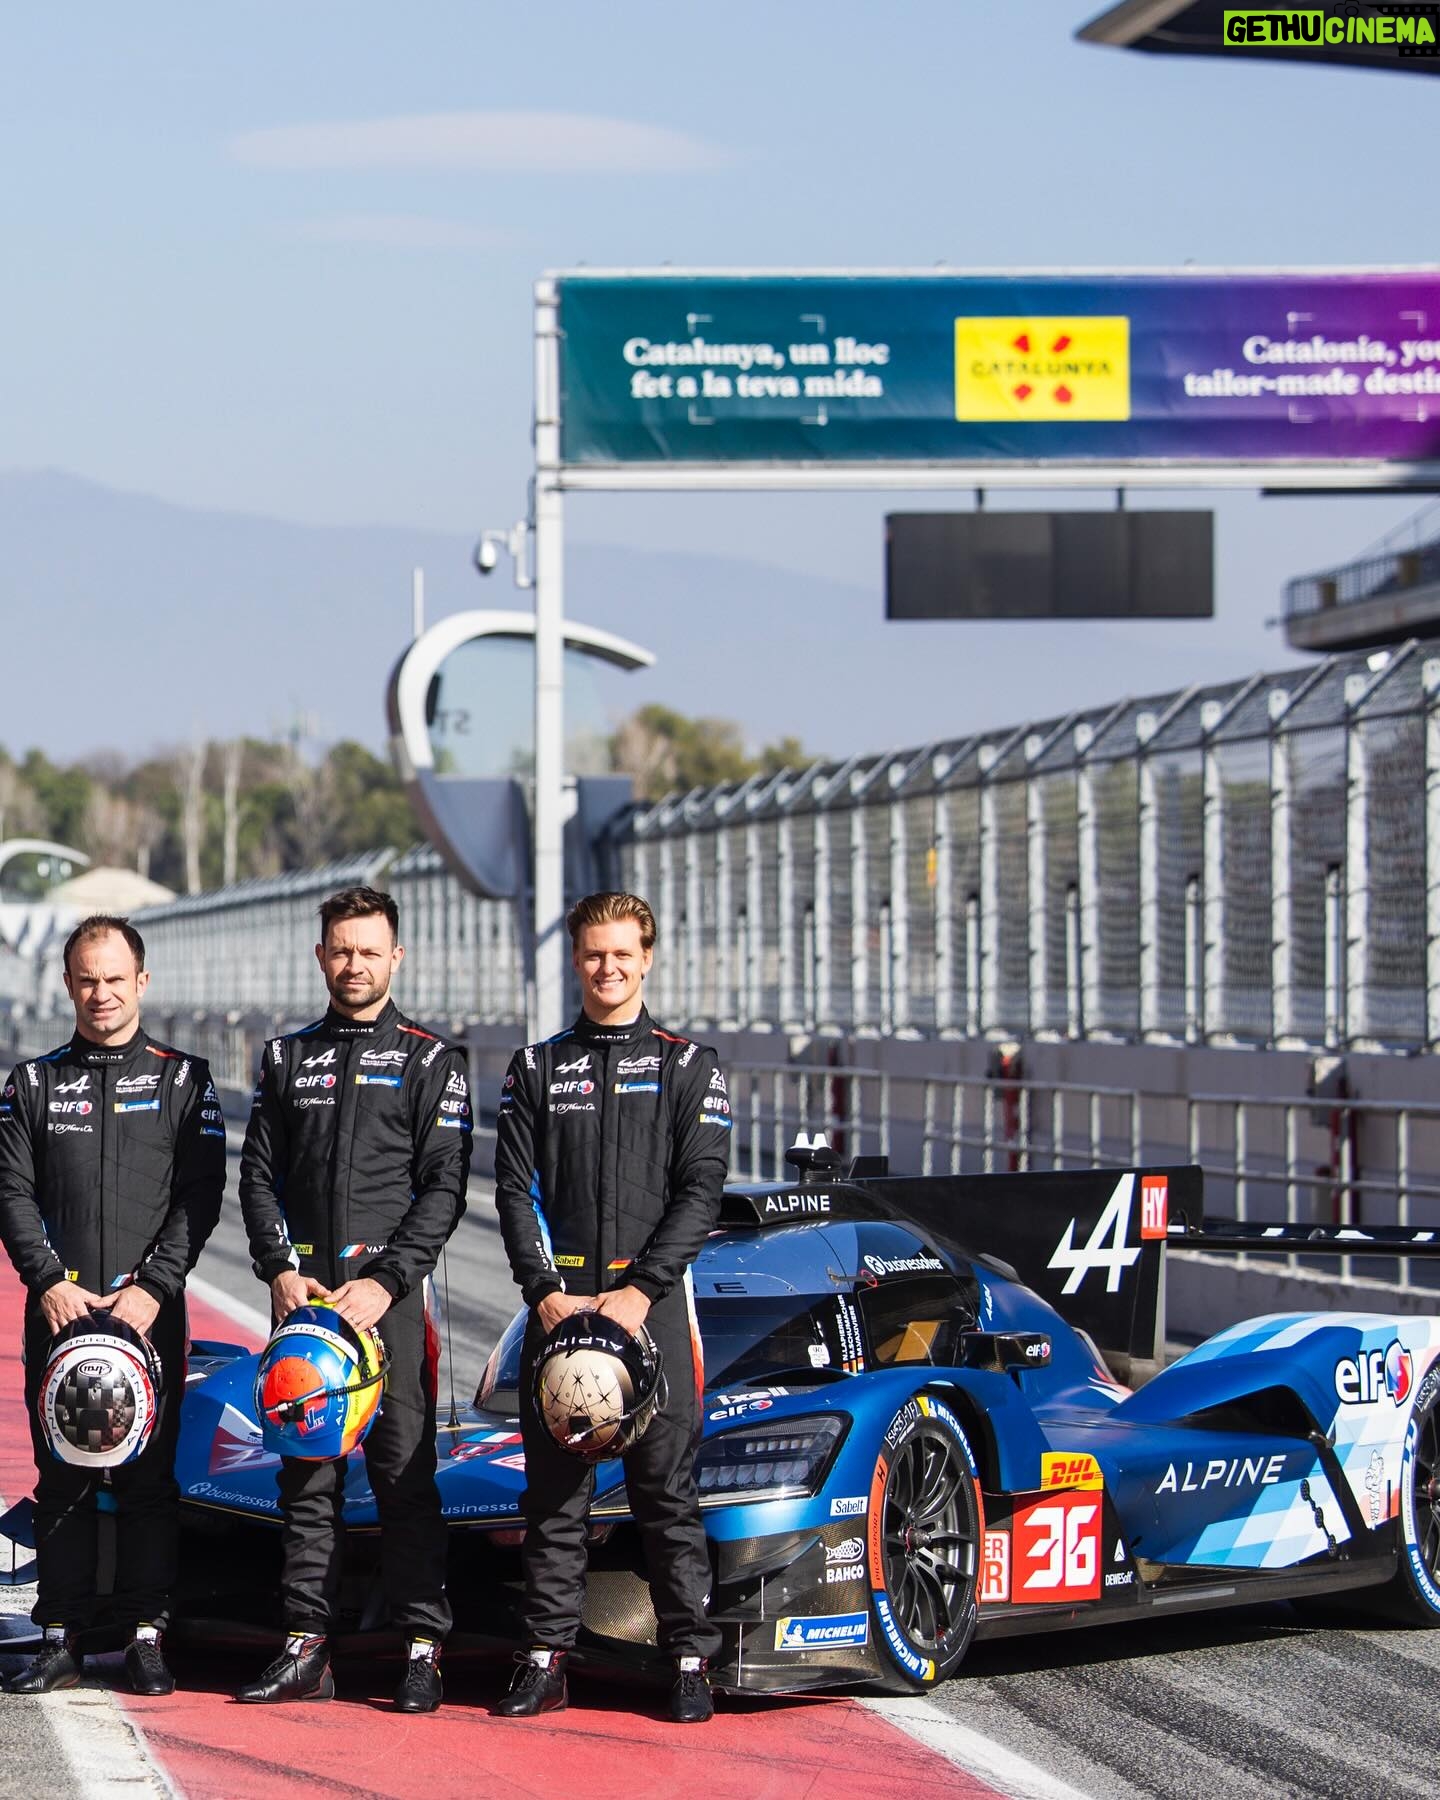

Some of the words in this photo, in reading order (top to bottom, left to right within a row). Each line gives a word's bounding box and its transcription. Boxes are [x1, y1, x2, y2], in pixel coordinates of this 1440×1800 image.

[623, 337, 785, 370] Catalunya,
[789, 343, 830, 365] un
[835, 336, 890, 365] lloc
[1242, 335, 1398, 367] Catalonia,
[1400, 339, 1440, 368] yo
[971, 360, 1112, 377] CATALUNYA
[1184, 368, 1360, 398] tailor-made
[1364, 366, 1440, 396] desti
[630, 369, 674, 398] fet
[676, 374, 698, 398] a
[701, 369, 732, 398] la
[736, 373, 800, 398] teva
[803, 368, 883, 398] mida
[422, 1041, 445, 1068] Sabelt
[295, 1074, 321, 1089] elf
[550, 1081, 577, 1094] elf
[50, 1101, 76, 1113] elf
[765, 1195, 830, 1212] ALPINE
[1142, 1187, 1167, 1229] HY
[554, 1256, 580, 1265] Sabelt
[836, 1314, 849, 1361] N.LAPIERRE
[837, 1294, 855, 1359] M.SCHUMACHER
[848, 1305, 862, 1356] M.VAXIVIERE
[1026, 1345, 1041, 1357] elf
[1335, 1351, 1384, 1403] elf
[709, 1403, 748, 1421] elf
[1050, 1458, 1095, 1485] DHL
[1155, 1455, 1287, 1494] ALPINE
[206, 1485, 278, 1510] businessolv
[441, 1503, 519, 1515] usinesso
[835, 1499, 864, 1515] Sabelt
[1023, 1504, 1098, 1589] 36
[827, 1564, 864, 1584] BAHCO
[806, 1623, 866, 1640] MICHELIN
[878, 1600, 919, 1671] MICHELIN
